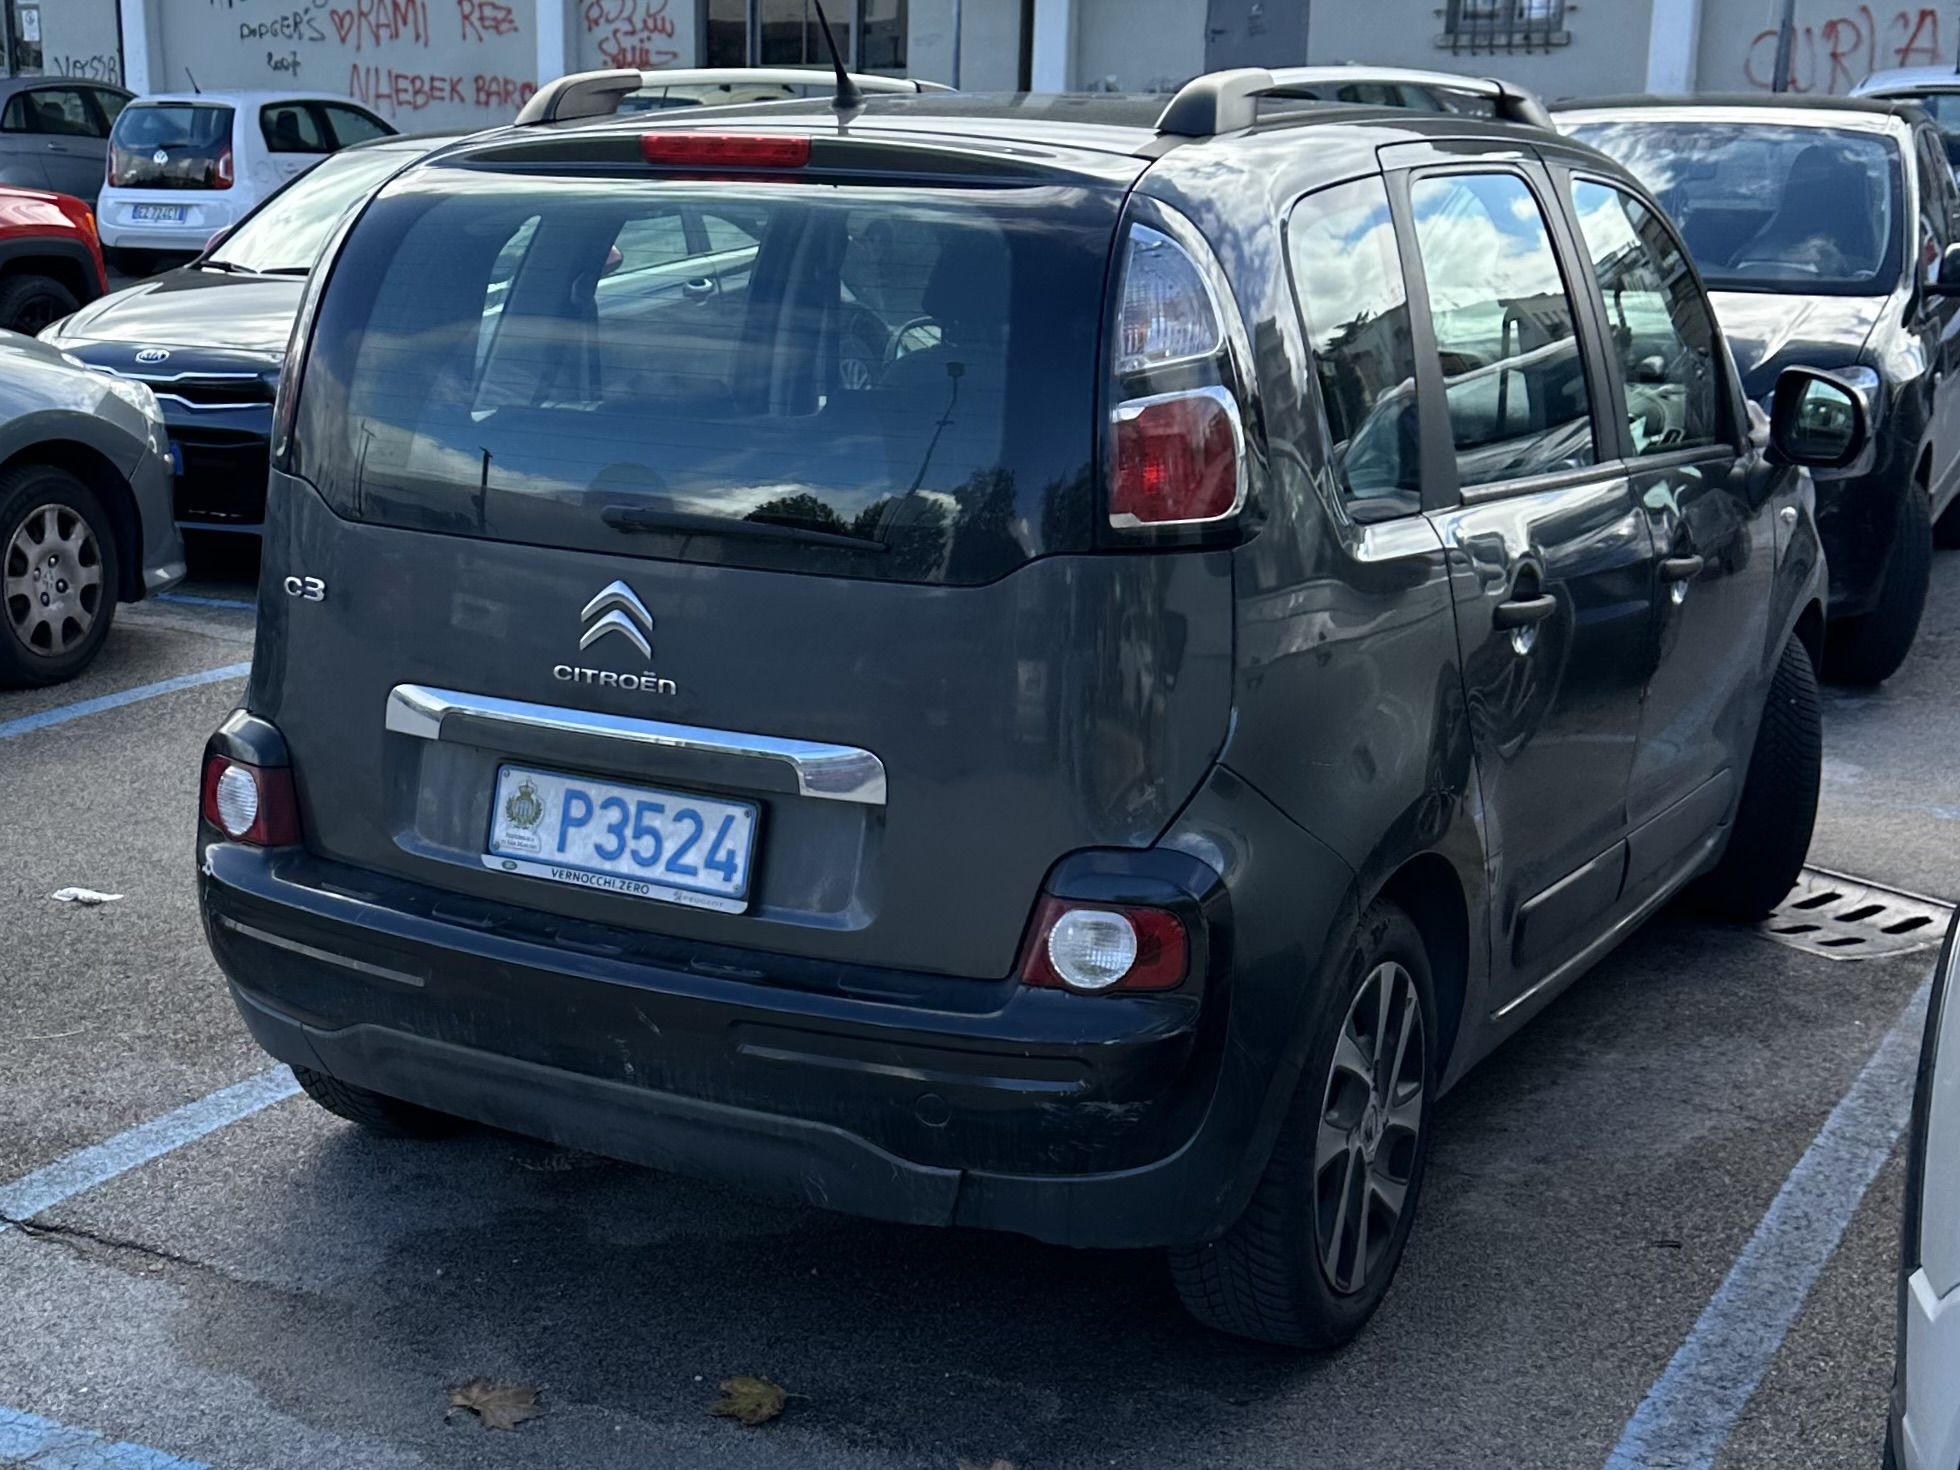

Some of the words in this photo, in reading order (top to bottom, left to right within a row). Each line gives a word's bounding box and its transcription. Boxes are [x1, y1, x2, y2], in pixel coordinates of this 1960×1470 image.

[138, 351, 167, 362] KIA
[283, 576, 326, 602] C3
[553, 663, 678, 696] CITROËN
[556, 787, 739, 883] P3524
